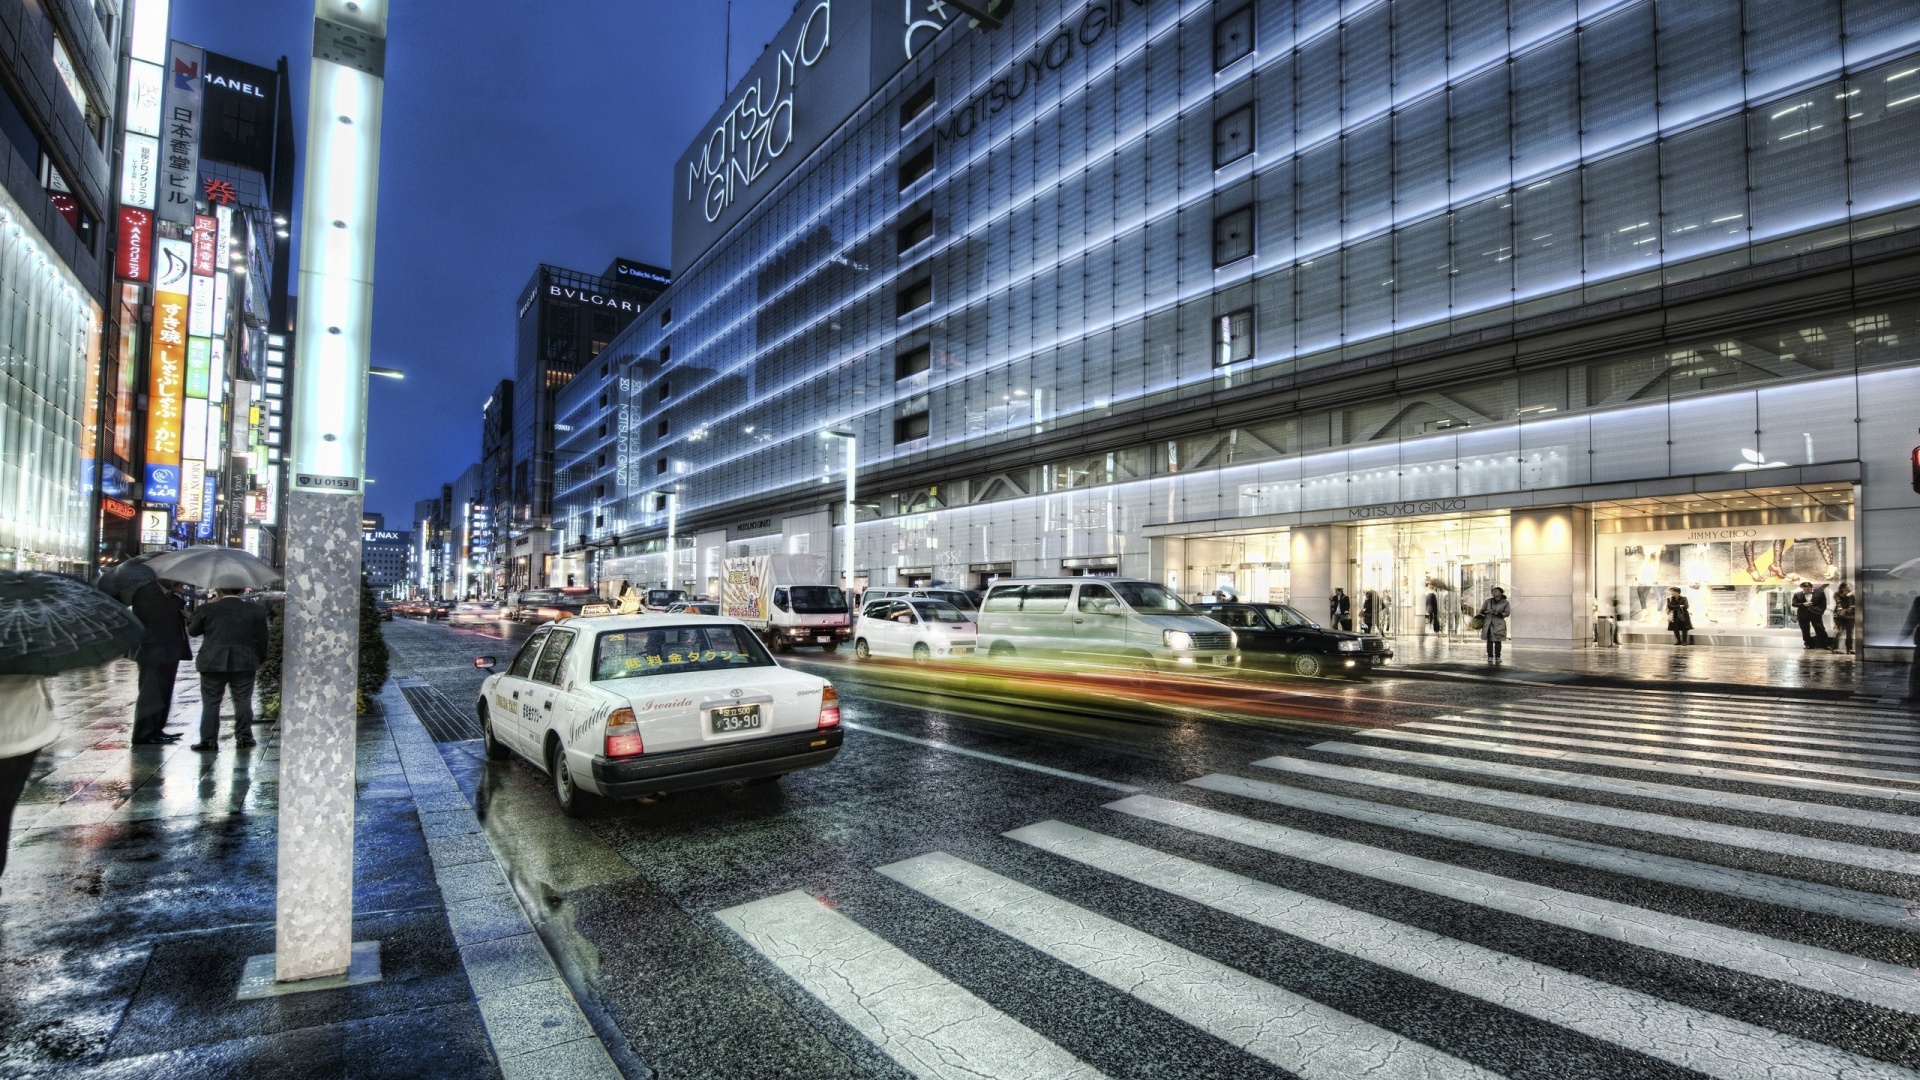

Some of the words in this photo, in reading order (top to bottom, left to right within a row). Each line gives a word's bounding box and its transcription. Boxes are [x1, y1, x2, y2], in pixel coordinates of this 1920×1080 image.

[168, 106, 193, 204] 日本香堂ビル
[203, 177, 236, 206] 券
[128, 227, 141, 278] AACクリニック
[550, 285, 642, 313] BVLGARI
[325, 479, 349, 487] 0153
[200, 482, 213, 535] CHAUMET
[375, 531, 399, 539] INAX
[1687, 531, 1718, 540] JIMMY
[1720, 528, 1757, 539] CHOO
[624, 650, 750, 670] 低料金タクシー
[642, 697, 694, 712] Iwaida
[723, 714, 759, 731] 39-90
